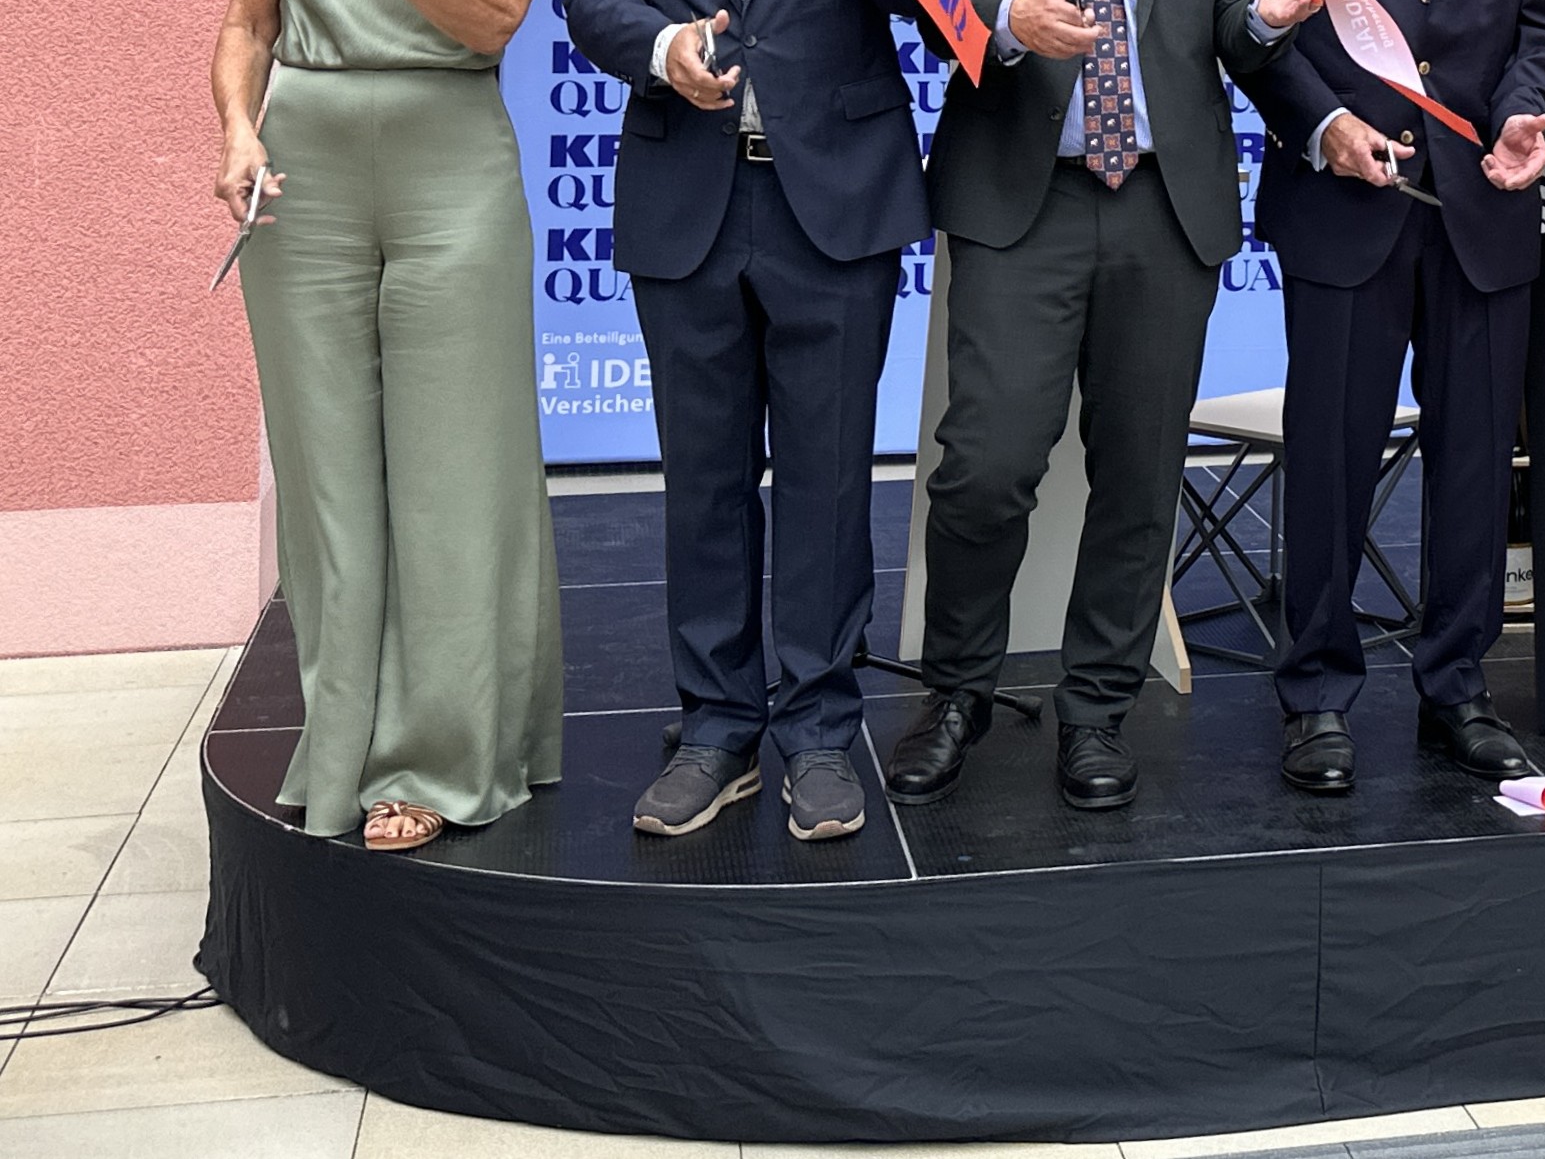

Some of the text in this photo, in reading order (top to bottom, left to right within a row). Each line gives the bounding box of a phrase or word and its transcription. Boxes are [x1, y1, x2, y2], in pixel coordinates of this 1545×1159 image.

[541, 330, 644, 346] Eine Beteiligun
[590, 358, 652, 389] IDE
[540, 393, 654, 415] Versicher
